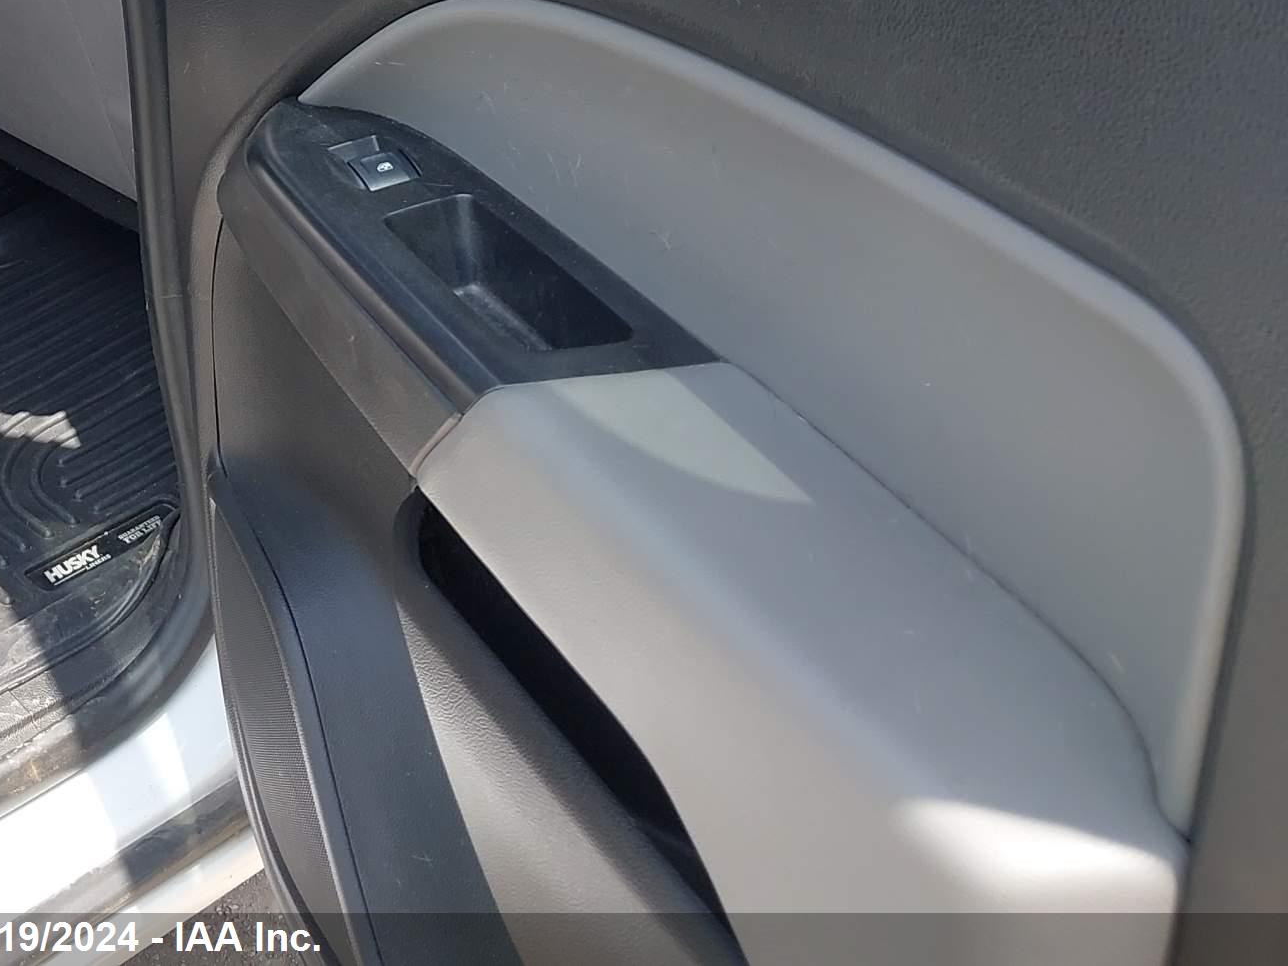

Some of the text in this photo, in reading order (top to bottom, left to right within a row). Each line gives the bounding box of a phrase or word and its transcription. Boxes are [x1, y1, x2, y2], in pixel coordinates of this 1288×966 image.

[122, 530, 144, 544] FOR
[44, 545, 100, 583] HUSKY
[85, 554, 112, 570] LINERS
